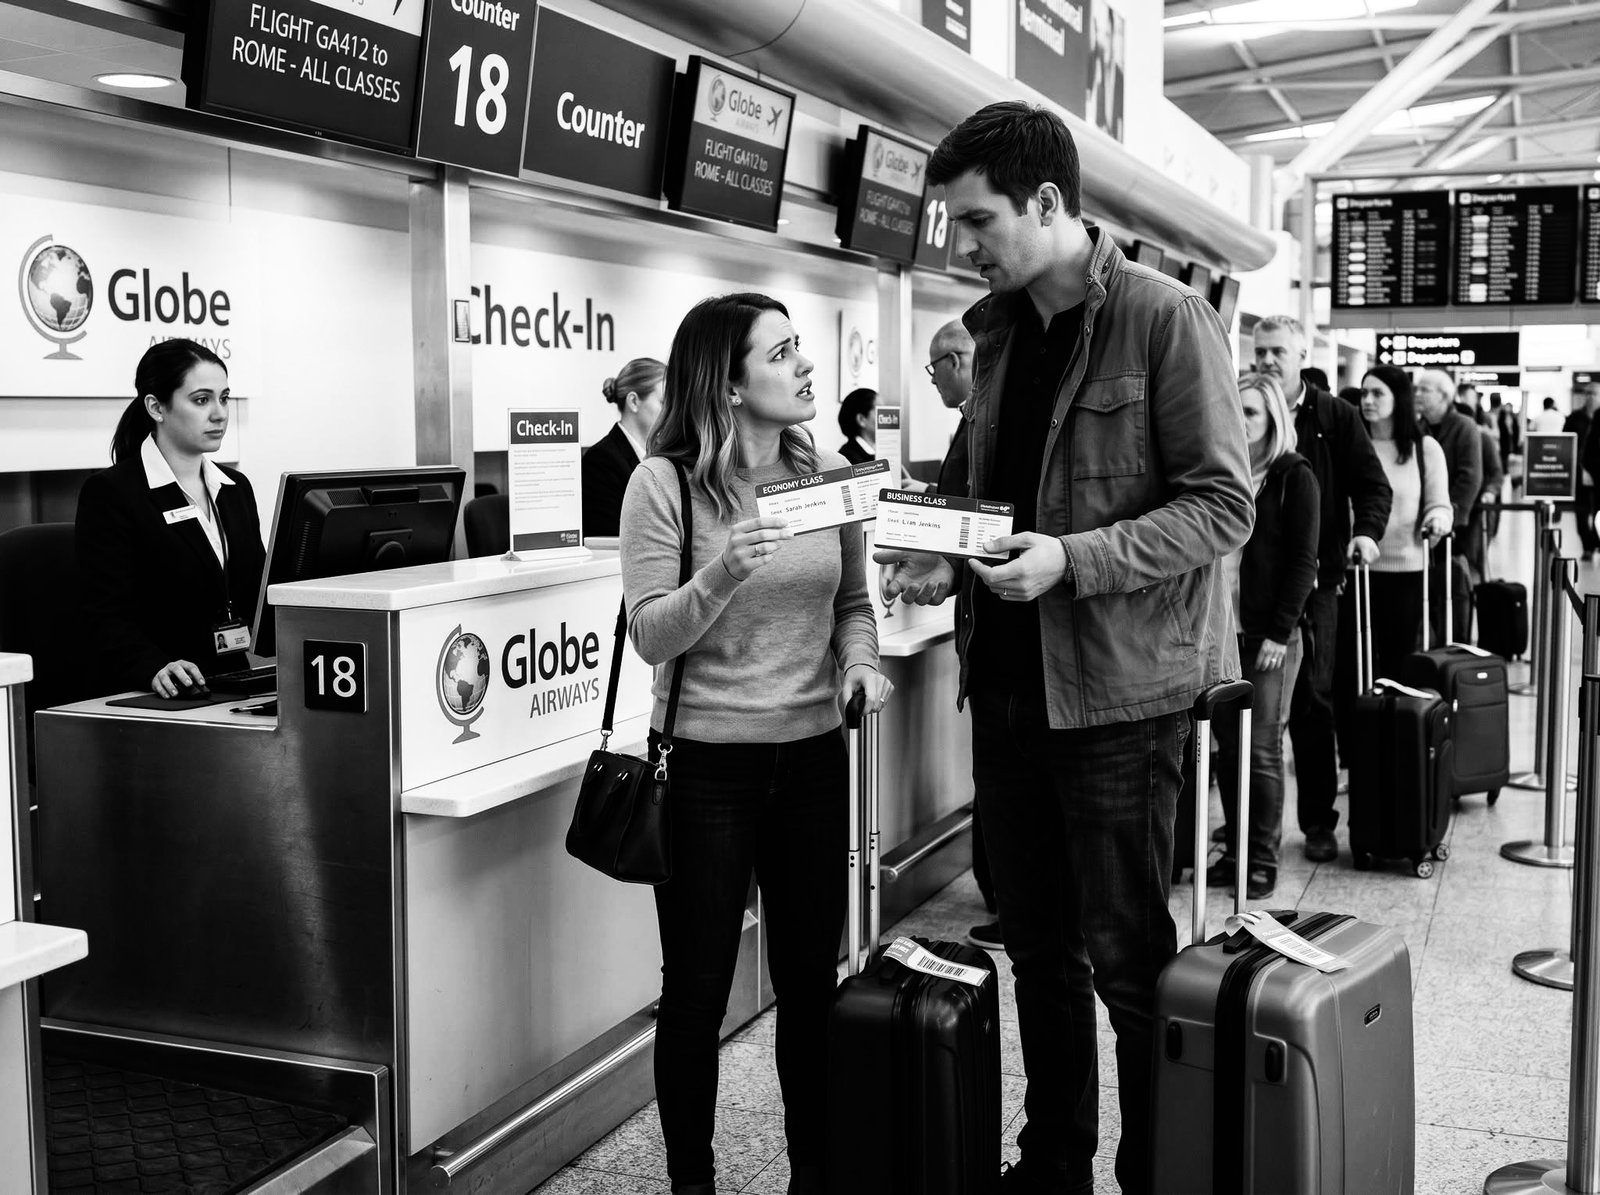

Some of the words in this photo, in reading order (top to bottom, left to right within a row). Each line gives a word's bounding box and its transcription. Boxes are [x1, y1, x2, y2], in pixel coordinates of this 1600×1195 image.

[250, 3, 313, 44] FLIGHT
[316, 24, 368, 61] GA412
[373, 44, 388, 66] to
[232, 36, 287, 73] ROME
[300, 56, 330, 85] ALL
[335, 65, 400, 103] CLASSES
[449, 44, 509, 135] 18
[557, 91, 645, 149] Counter
[729, 89, 762, 119] Globe
[694, 160, 721, 182] ROME
[725, 169, 739, 188] ALL
[108, 268, 231, 326] Globe
[516, 419, 573, 437] Check-In
[763, 479, 799, 494] ECONOMY
[800, 475, 824, 487] CLASS
[886, 492, 922, 503] BUSINESS
[923, 496, 947, 506] CLASS
[786, 504, 802, 513] Sarah
[804, 500, 826, 509] Jenkins
[919, 521, 941, 529] Jenkins
[311, 654, 357, 698] 18
[501, 622, 599, 689] Globe
[529, 677, 600, 719] AIRWAYS
